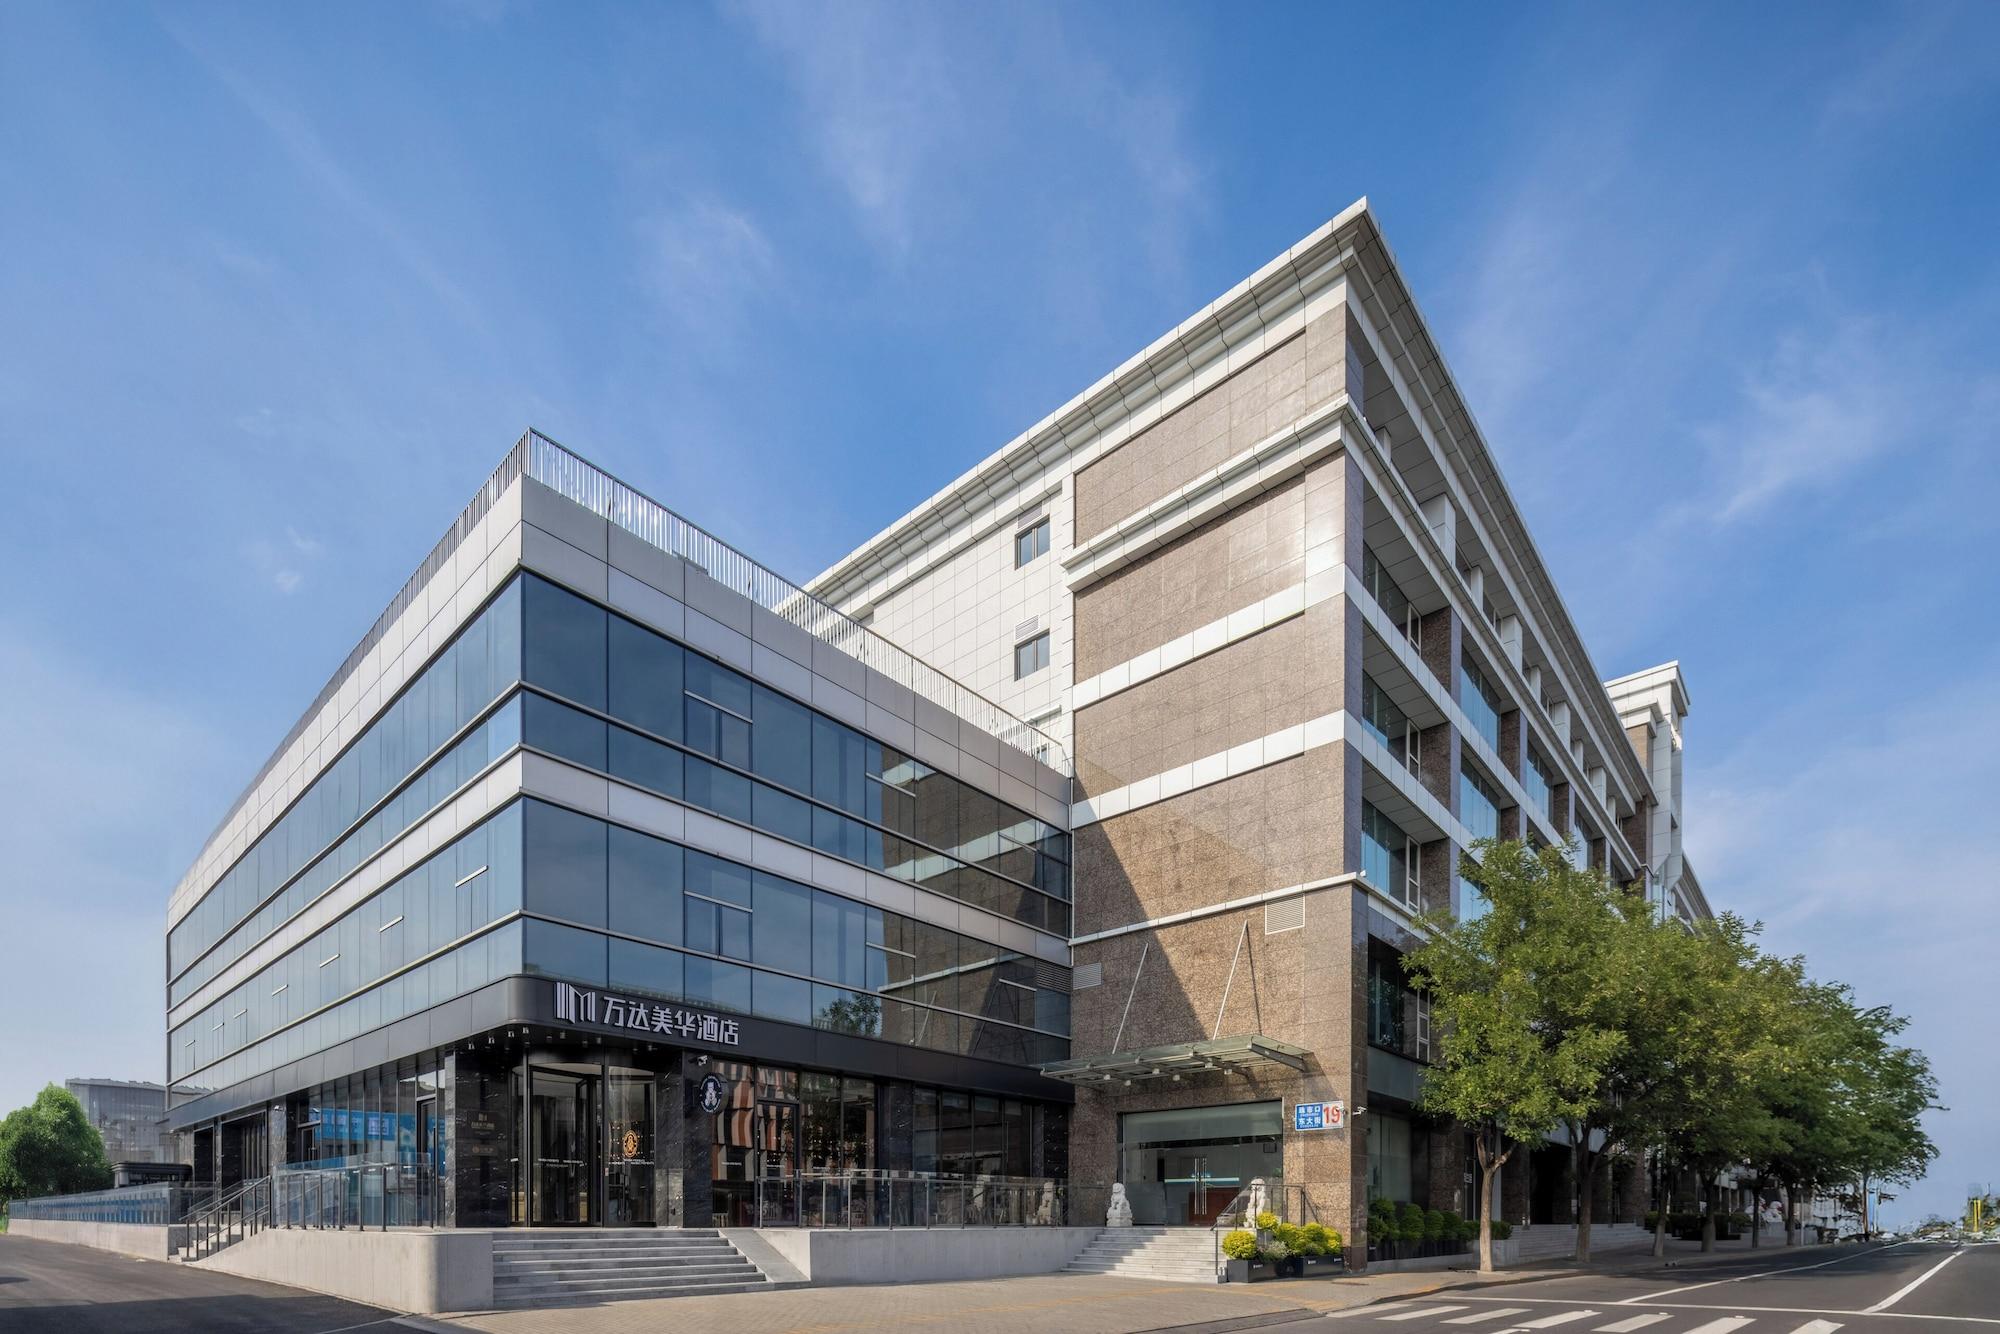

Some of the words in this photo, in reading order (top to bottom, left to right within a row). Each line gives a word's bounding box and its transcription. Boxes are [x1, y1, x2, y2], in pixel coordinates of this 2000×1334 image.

[603, 996, 739, 1046] 万达美华酒店
[1323, 1105, 1341, 1124] 19
